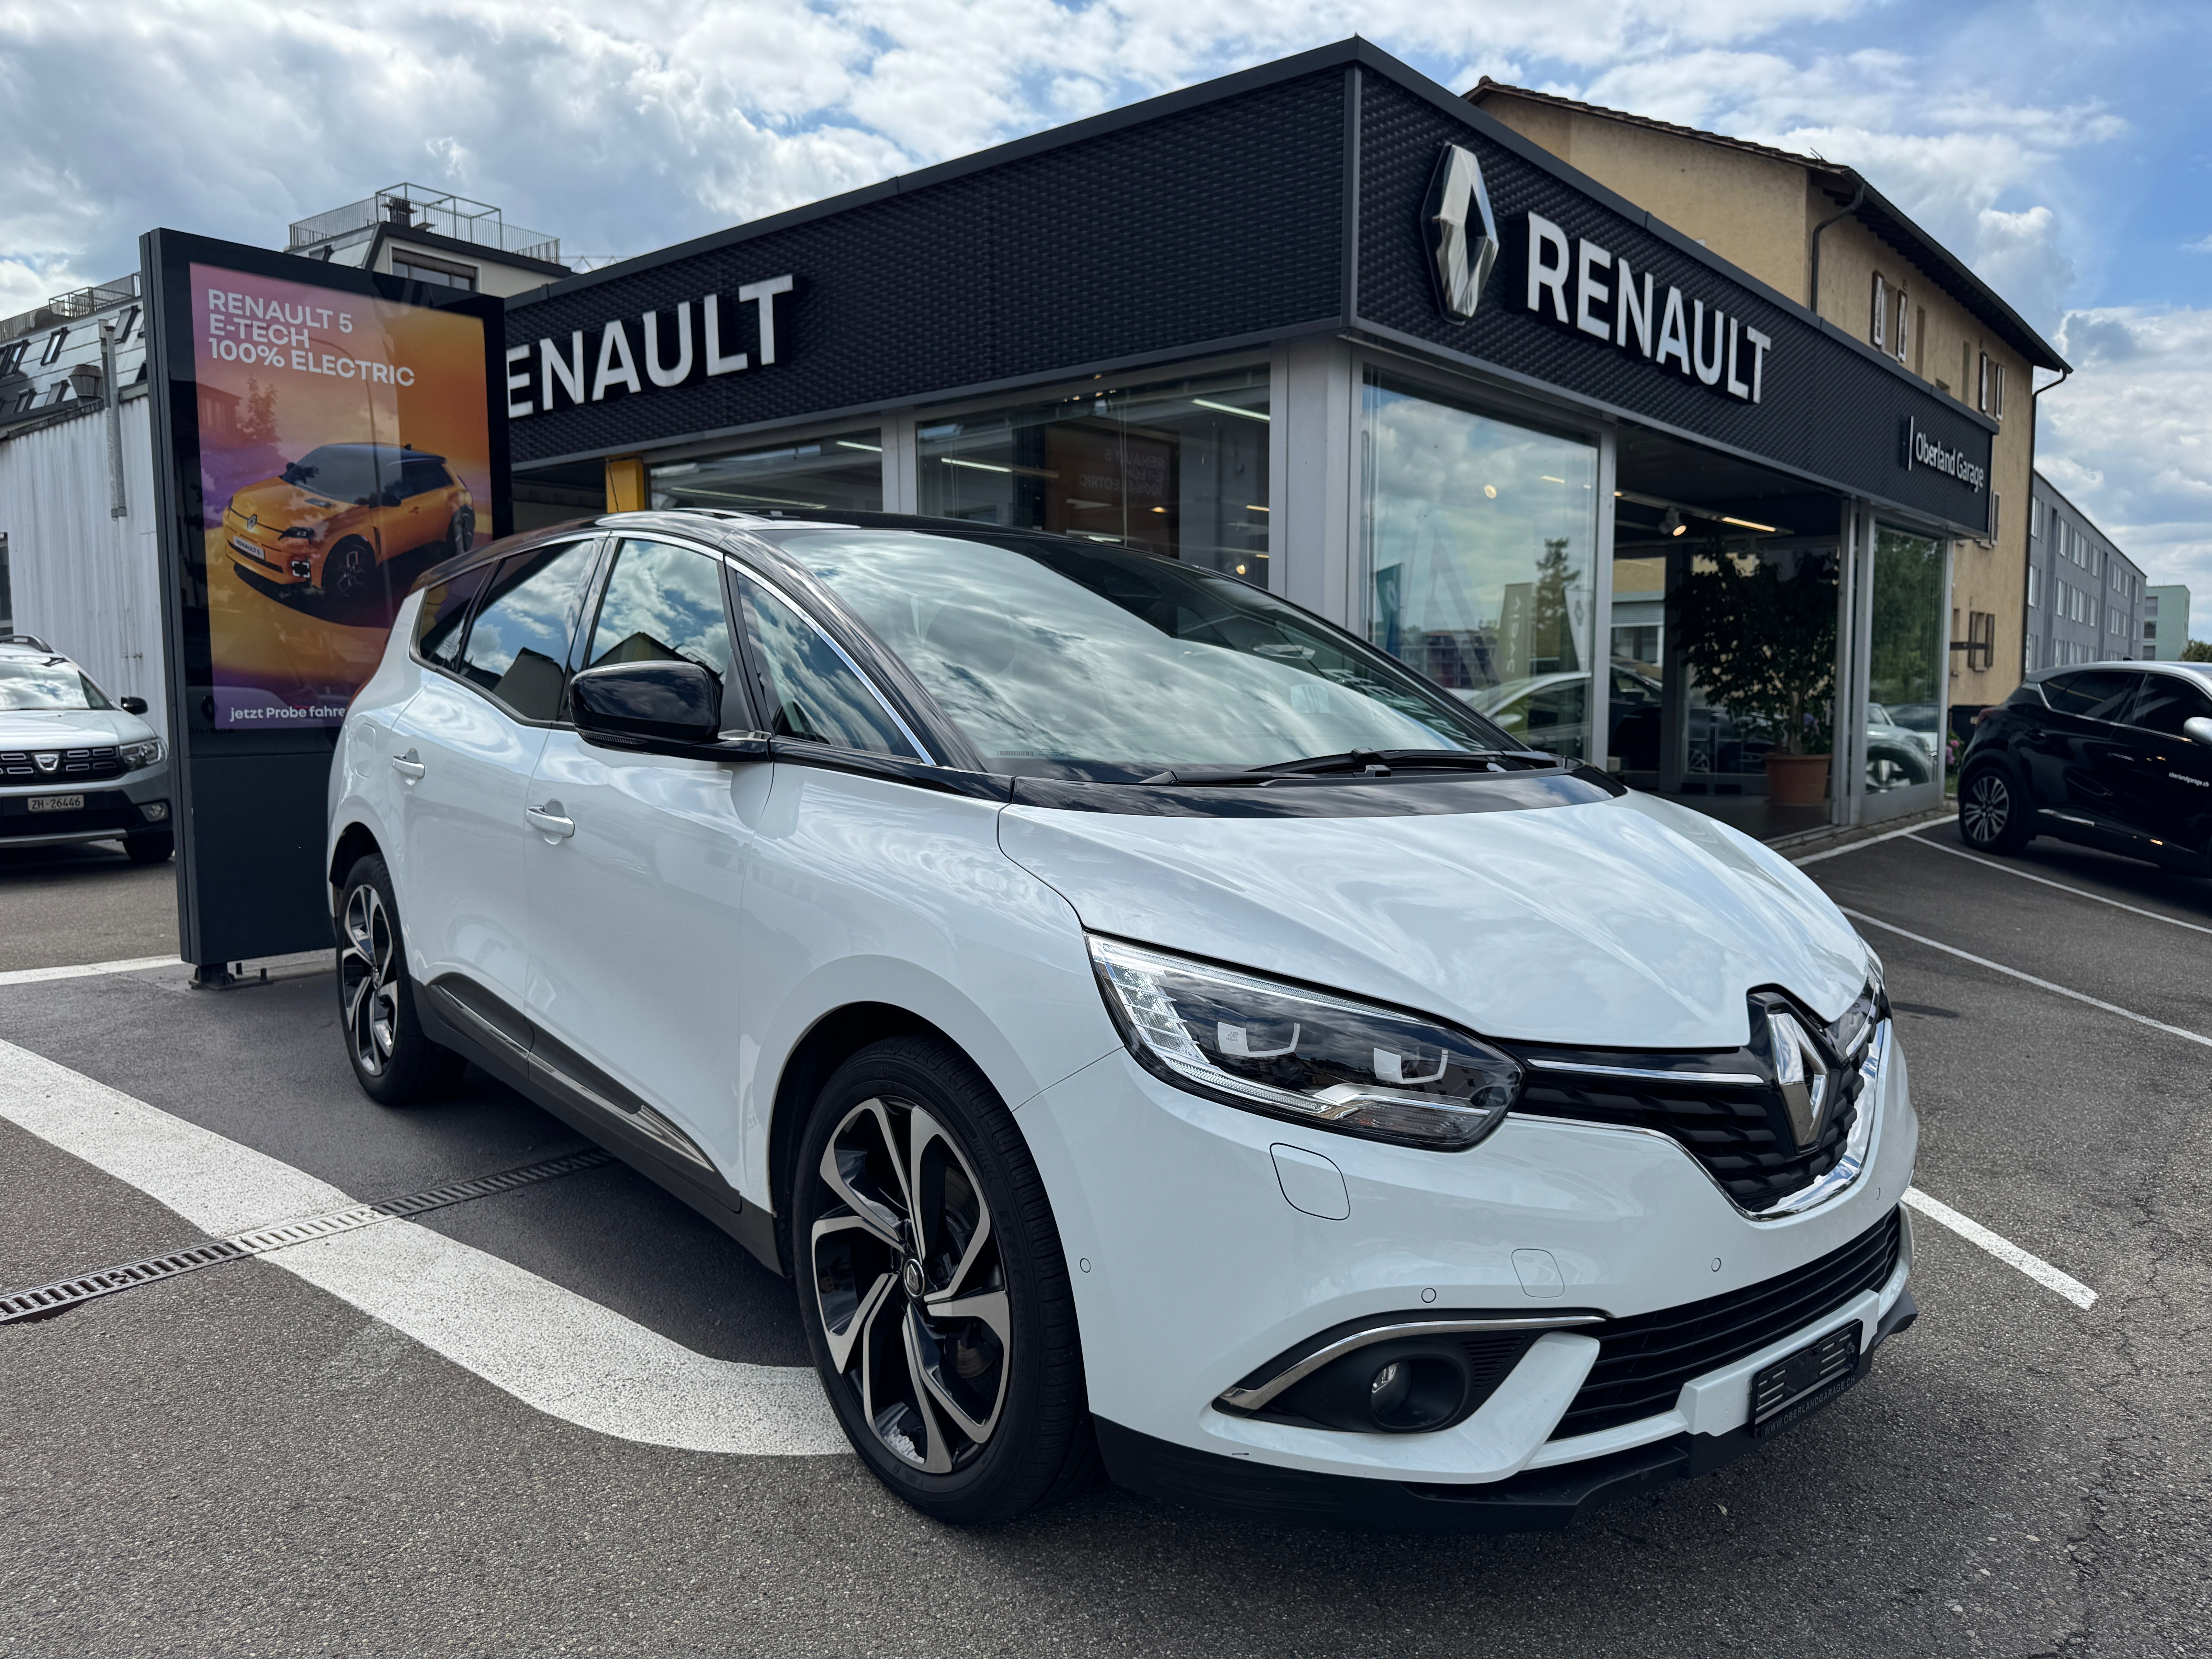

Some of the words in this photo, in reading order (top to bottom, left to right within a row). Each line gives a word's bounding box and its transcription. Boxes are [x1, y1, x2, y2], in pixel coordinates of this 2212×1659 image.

[208, 289, 333, 329] RENAULT
[339, 313, 353, 333] 5
[1527, 211, 1771, 404] RENAULT
[210, 313, 309, 349] E-TECH
[507, 274, 793, 419] ENAULT
[208, 338, 285, 368] 100%
[291, 349, 415, 386] ELECTRIC
[1916, 432, 1955, 476] Oberland
[1957, 452, 1984, 493] Garage
[236, 538, 256, 554] RENAULT
[230, 707, 264, 722] jetzt
[266, 706, 307, 718] Probe
[309, 706, 346, 717] fahre
[50, 798, 81, 808] 26446
[1764, 1375, 1855, 1436] WWW.OBERLANDGARAGE.CH
